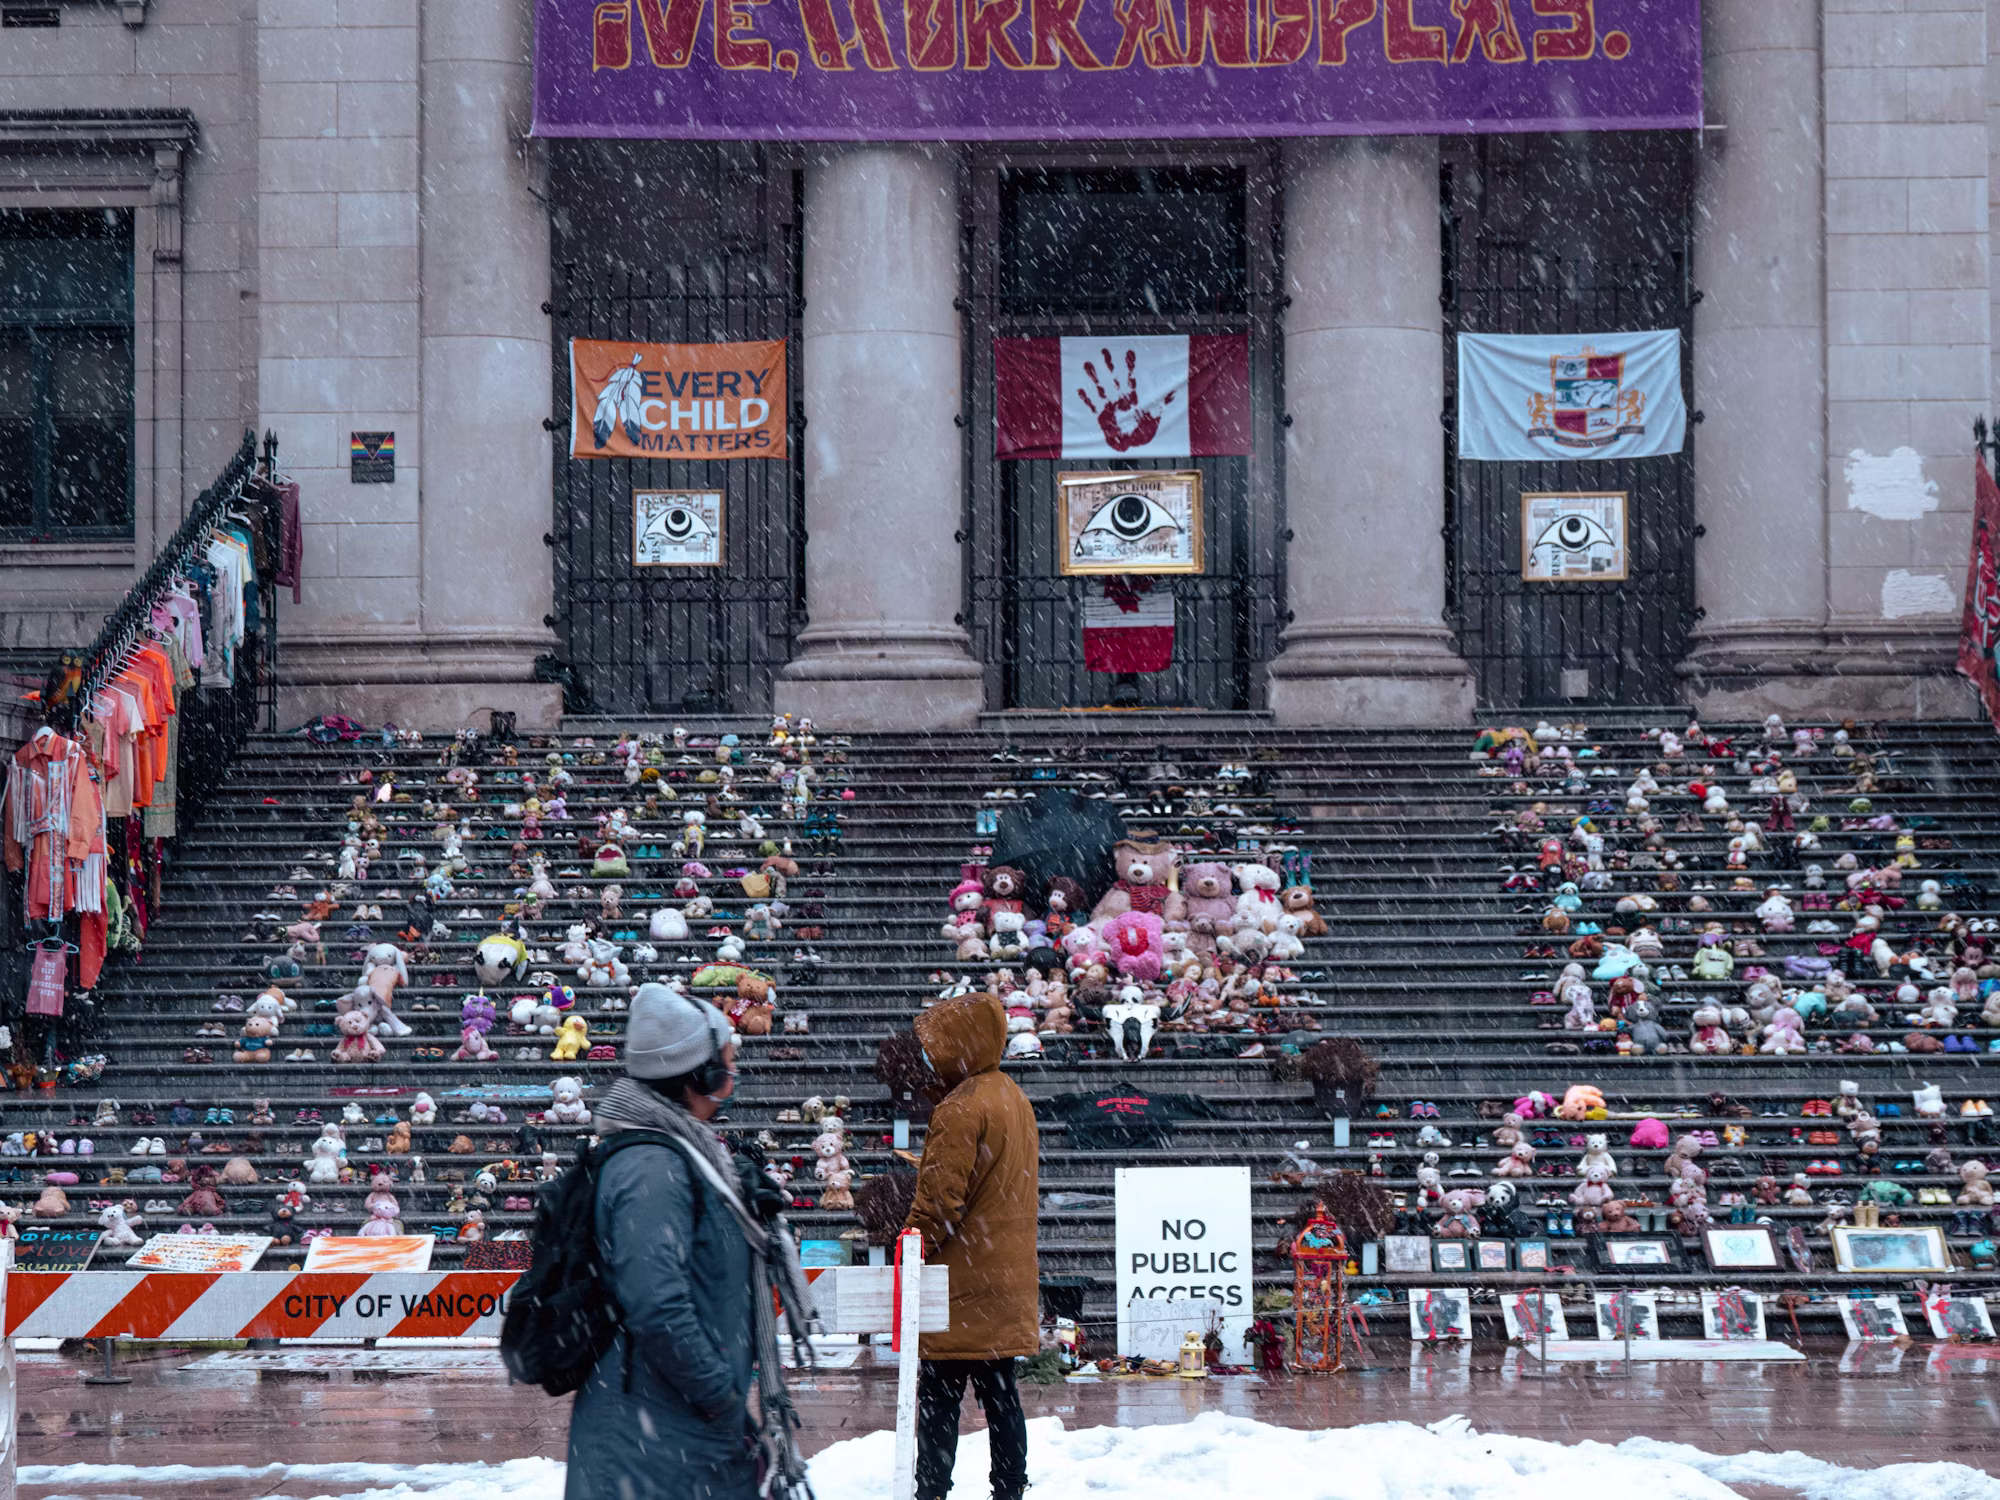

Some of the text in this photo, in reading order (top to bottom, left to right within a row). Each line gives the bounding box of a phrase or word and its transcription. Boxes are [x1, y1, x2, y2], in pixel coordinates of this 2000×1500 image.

[641, 370, 769, 397] EVERY
[640, 399, 769, 430] CHILD
[641, 431, 770, 451] MATTERS
[41, 1232, 100, 1241] PEACE
[1161, 1218, 1207, 1240] NO
[36, 1245, 95, 1257] LOVE
[1131, 1251, 1238, 1274] PUBLIC
[284, 1294, 348, 1318] CITY
[355, 1294, 392, 1317] OF
[1127, 1285, 1243, 1307] ACCESS
